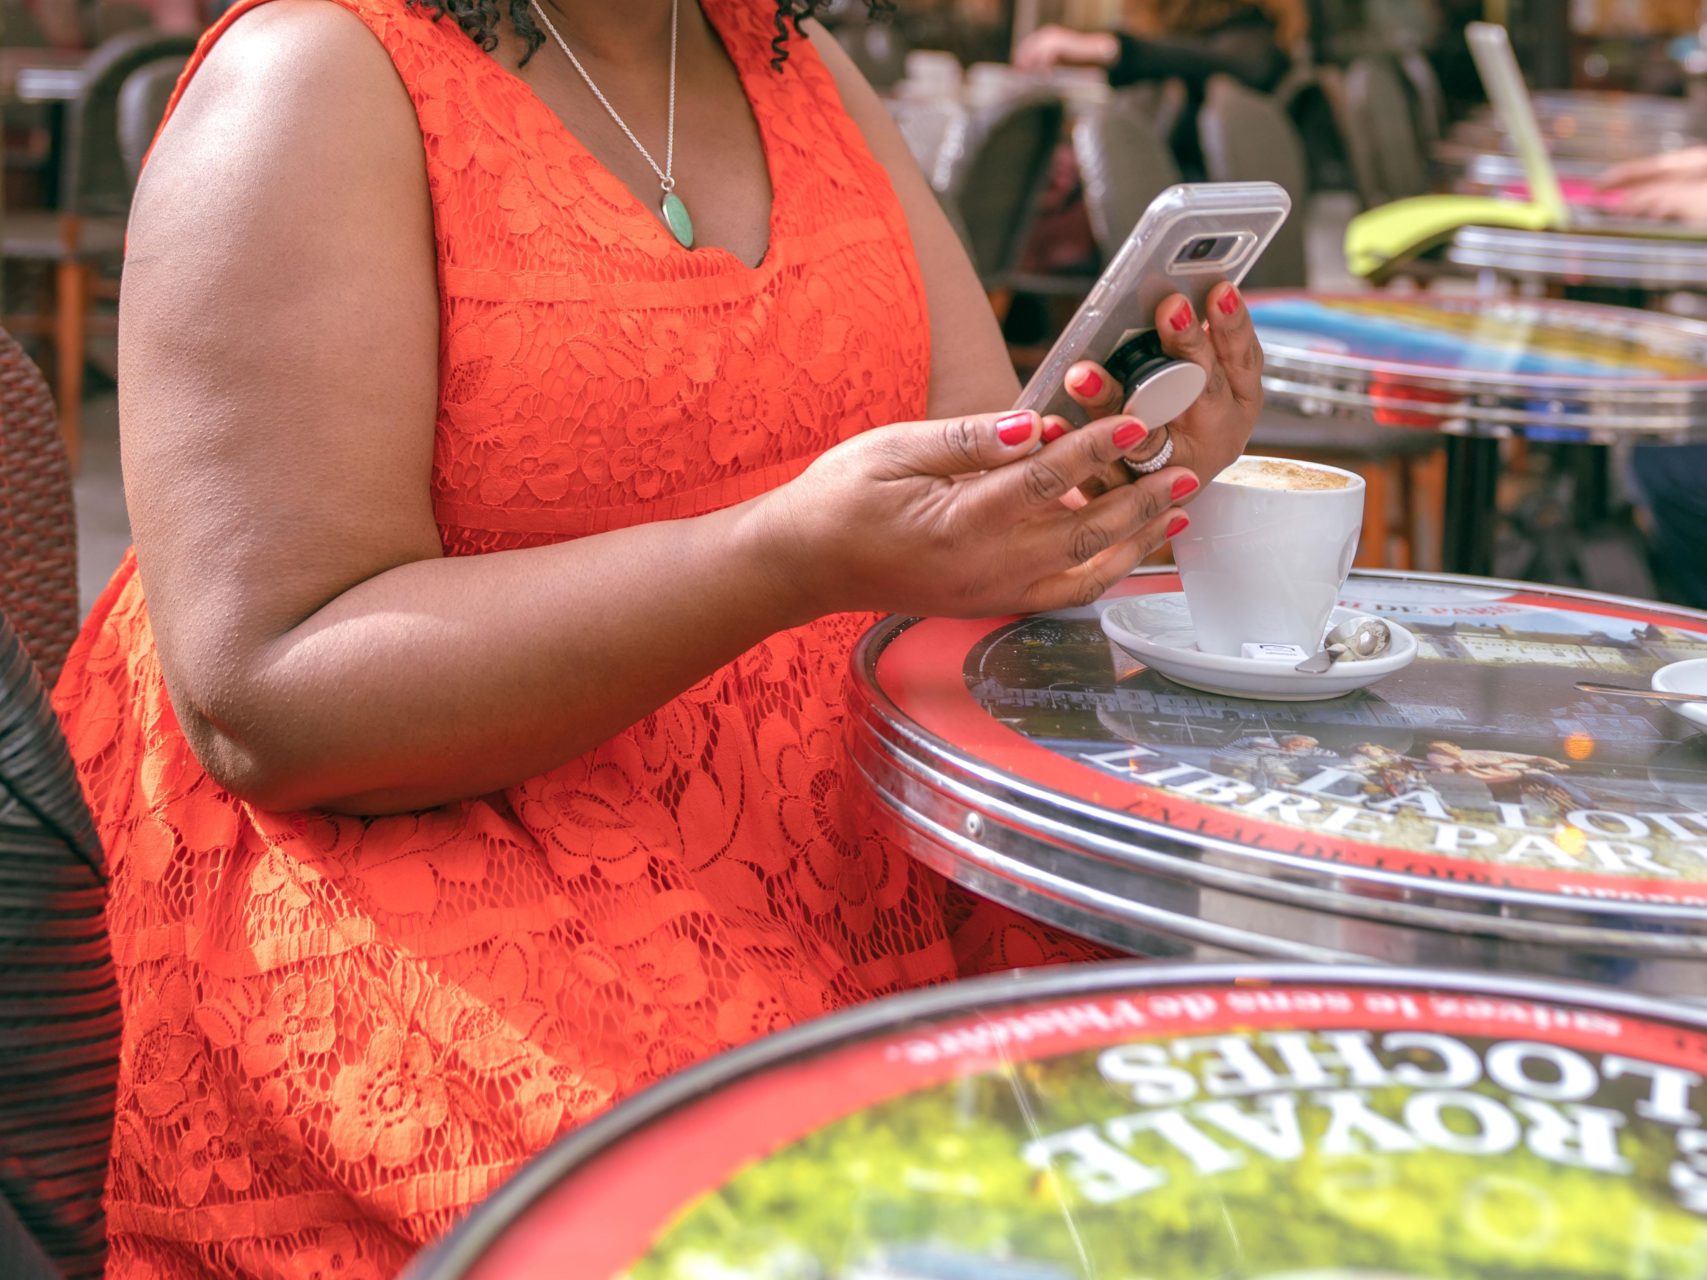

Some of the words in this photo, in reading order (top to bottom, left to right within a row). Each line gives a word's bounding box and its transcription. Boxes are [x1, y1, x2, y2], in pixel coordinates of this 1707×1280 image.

[1079, 745, 1397, 841] LIBRE
[1281, 764, 1455, 821] LA
[1488, 800, 1707, 841] LOI
[1148, 992, 1217, 1021] de
[1225, 991, 1353, 1014] sens
[1364, 992, 1421, 1020] le
[1429, 991, 1622, 1037] suivez
[1098, 1030, 1704, 1126] LOCHES
[1022, 1088, 1632, 1204] ROYALE
